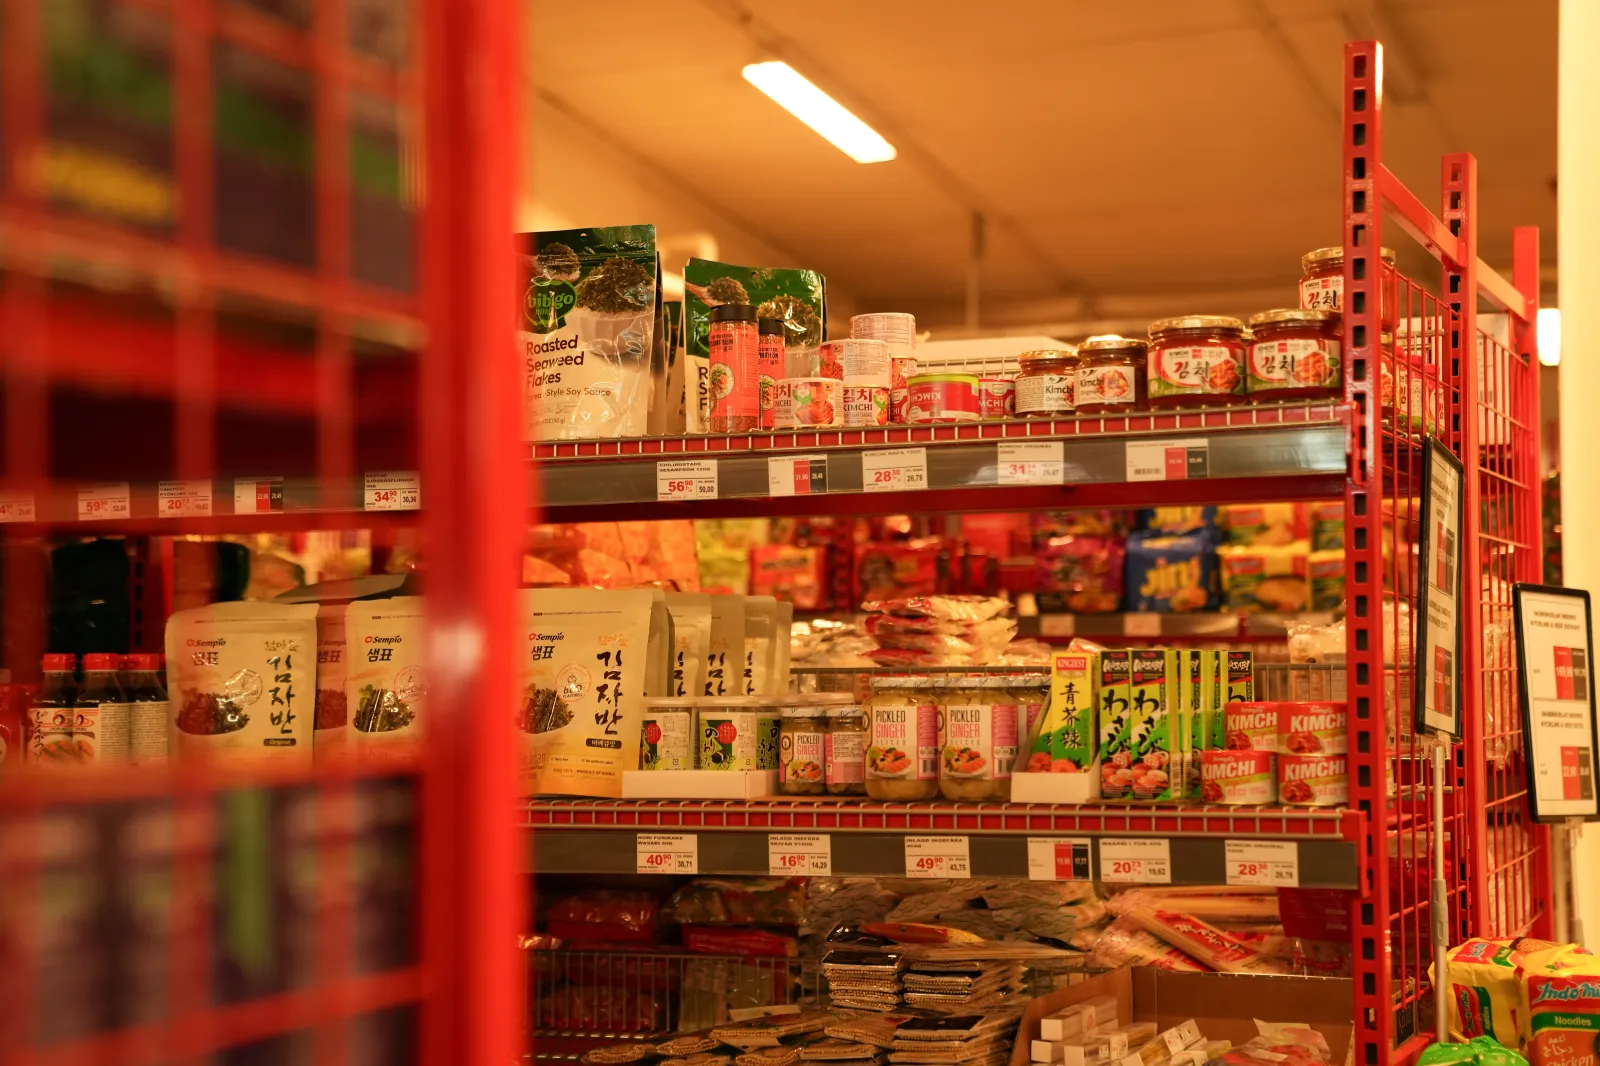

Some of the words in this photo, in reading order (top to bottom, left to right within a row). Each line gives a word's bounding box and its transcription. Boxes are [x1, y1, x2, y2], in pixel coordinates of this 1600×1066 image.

[528, 293, 574, 309] bibgo
[1308, 289, 1338, 309] 김치
[526, 335, 578, 356] Roasted
[527, 351, 585, 372] Seaweed
[1261, 355, 1296, 375] 김치
[1173, 360, 1210, 379] 김치
[527, 371, 561, 389] Flakes
[566, 387, 581, 396] Soy
[584, 387, 611, 397] Sauce
[979, 399, 1004, 408] MCHI
[195, 638, 226, 648] Sempio
[372, 634, 403, 645] Sempio
[535, 632, 565, 642] Sempio
[367, 648, 394, 662] 샘표
[531, 645, 555, 661] 샘표
[1103, 659, 1129, 672] WASAB
[704, 652, 727, 696] 김자
[267, 654, 296, 734] 김자반
[594, 650, 624, 735] 김자반
[875, 710, 906, 723] PICKLED
[950, 710, 980, 722] PICKLED
[1227, 712, 1278, 731] KIMCH
[1290, 712, 1347, 734] KIMCH
[875, 723, 906, 738] GINGER
[950, 723, 980, 738] GINGER
[797, 735, 821, 744] PICKLED
[1201, 760, 1256, 780] KIMCHI
[811, 861, 828, 870] 14,29
[950, 863, 967, 872] 43,75
[1554, 1015, 1592, 1027] Noodles
